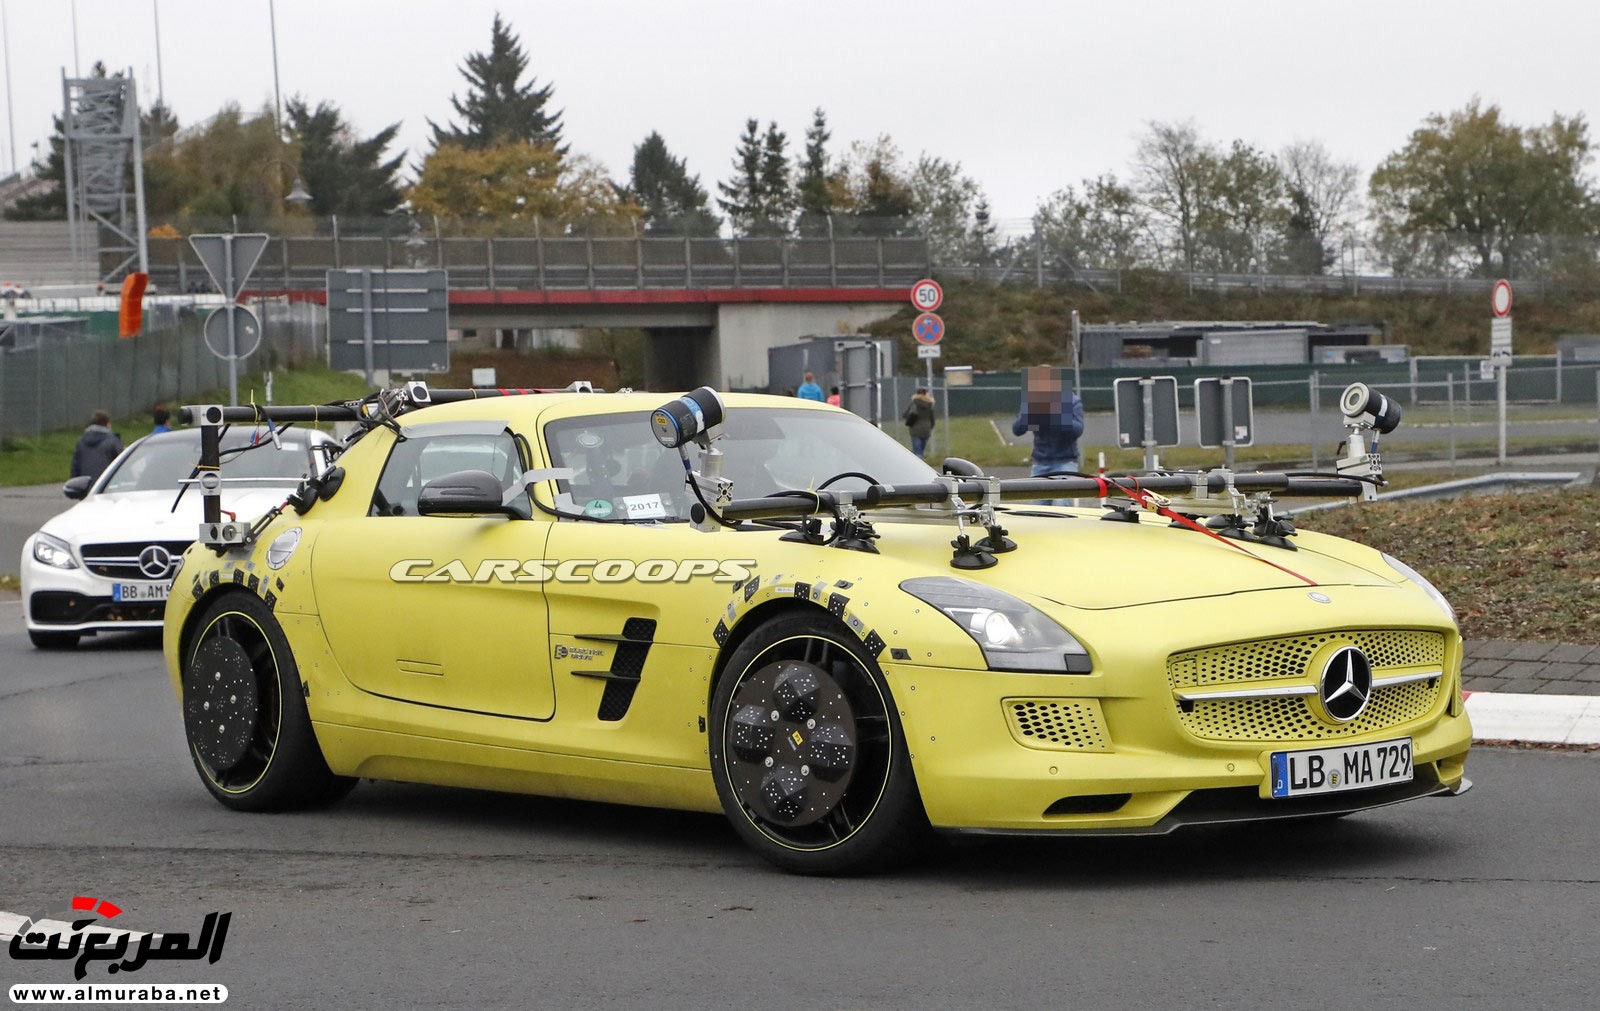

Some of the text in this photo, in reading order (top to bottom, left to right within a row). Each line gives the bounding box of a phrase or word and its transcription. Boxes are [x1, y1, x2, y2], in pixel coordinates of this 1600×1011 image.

[918, 288, 936, 303] 50
[594, 500, 602, 509] 4
[629, 501, 660, 512] 2017
[122, 585, 138, 599] BB
[147, 584, 163, 598] AM
[1289, 755, 1326, 790] LB
[1343, 750, 1374, 785] MA
[1377, 743, 1411, 780] 729
